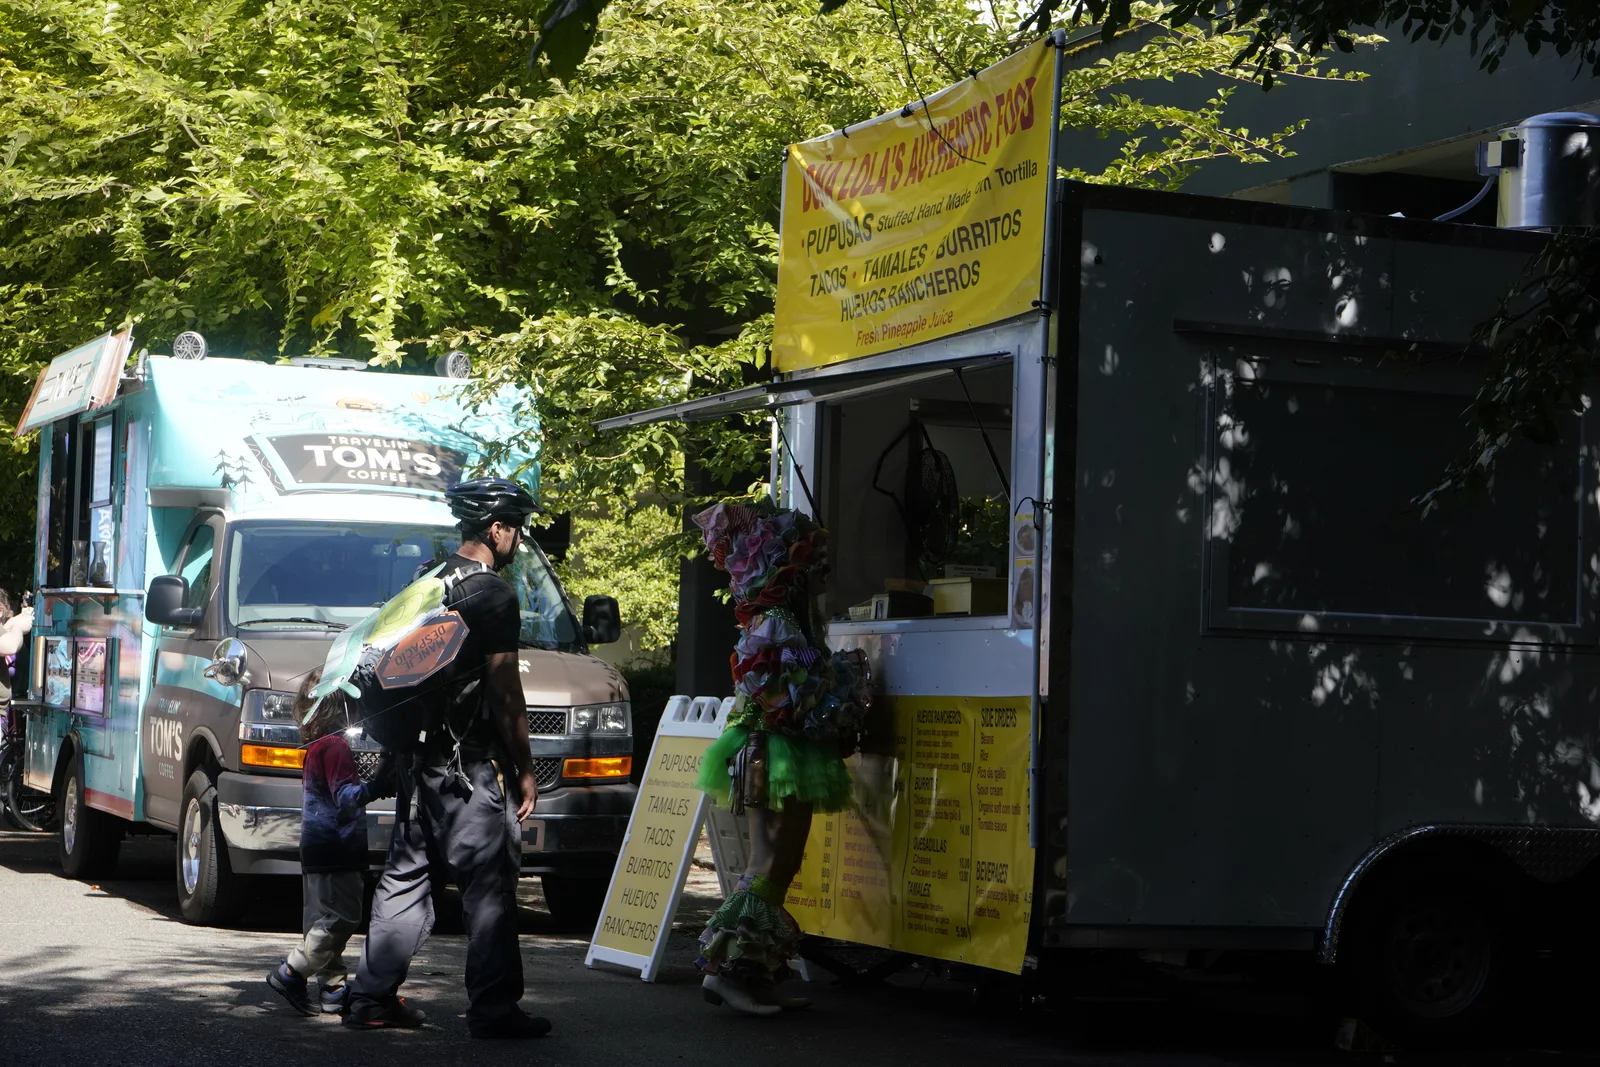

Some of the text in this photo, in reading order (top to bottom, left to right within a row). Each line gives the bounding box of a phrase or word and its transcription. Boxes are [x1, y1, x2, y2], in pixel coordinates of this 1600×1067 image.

[837, 142, 906, 201] LOLA'S
[903, 100, 992, 188] AUTHENTIC
[807, 213, 874, 258] PUPUSAS
[877, 210, 916, 234] Stuffed
[916, 201, 945, 220] Hand
[946, 190, 972, 212] Made
[994, 159, 1038, 187] Tortilla
[810, 209, 1022, 298] TACOS TAMALES BURRITOS
[841, 260, 981, 322] HUEVOS RANCHEROS
[855, 309, 954, 348] Fresh Pineapple Juice
[327, 435, 412, 449] TRAVELIN'
[303, 445, 442, 477] TOM'S
[346, 469, 407, 483] COFFEE
[394, 624, 447, 667] DESPACIO
[403, 636, 446, 673] MANEJE
[981, 707, 1018, 728] SIDE ORDERS
[149, 715, 183, 762] TOM'S
[981, 732, 995, 745] Beans
[980, 749, 989, 762] Rice
[914, 777, 938, 791] BURRITS
[647, 795, 690, 817] TAMALES
[644, 826, 676, 847] TACOS
[626, 856, 673, 879] BURRITOS
[620, 888, 659, 910] HUEVOS
[907, 881, 931, 897] TAMALES
[603, 915, 658, 942] RANCHEROS
